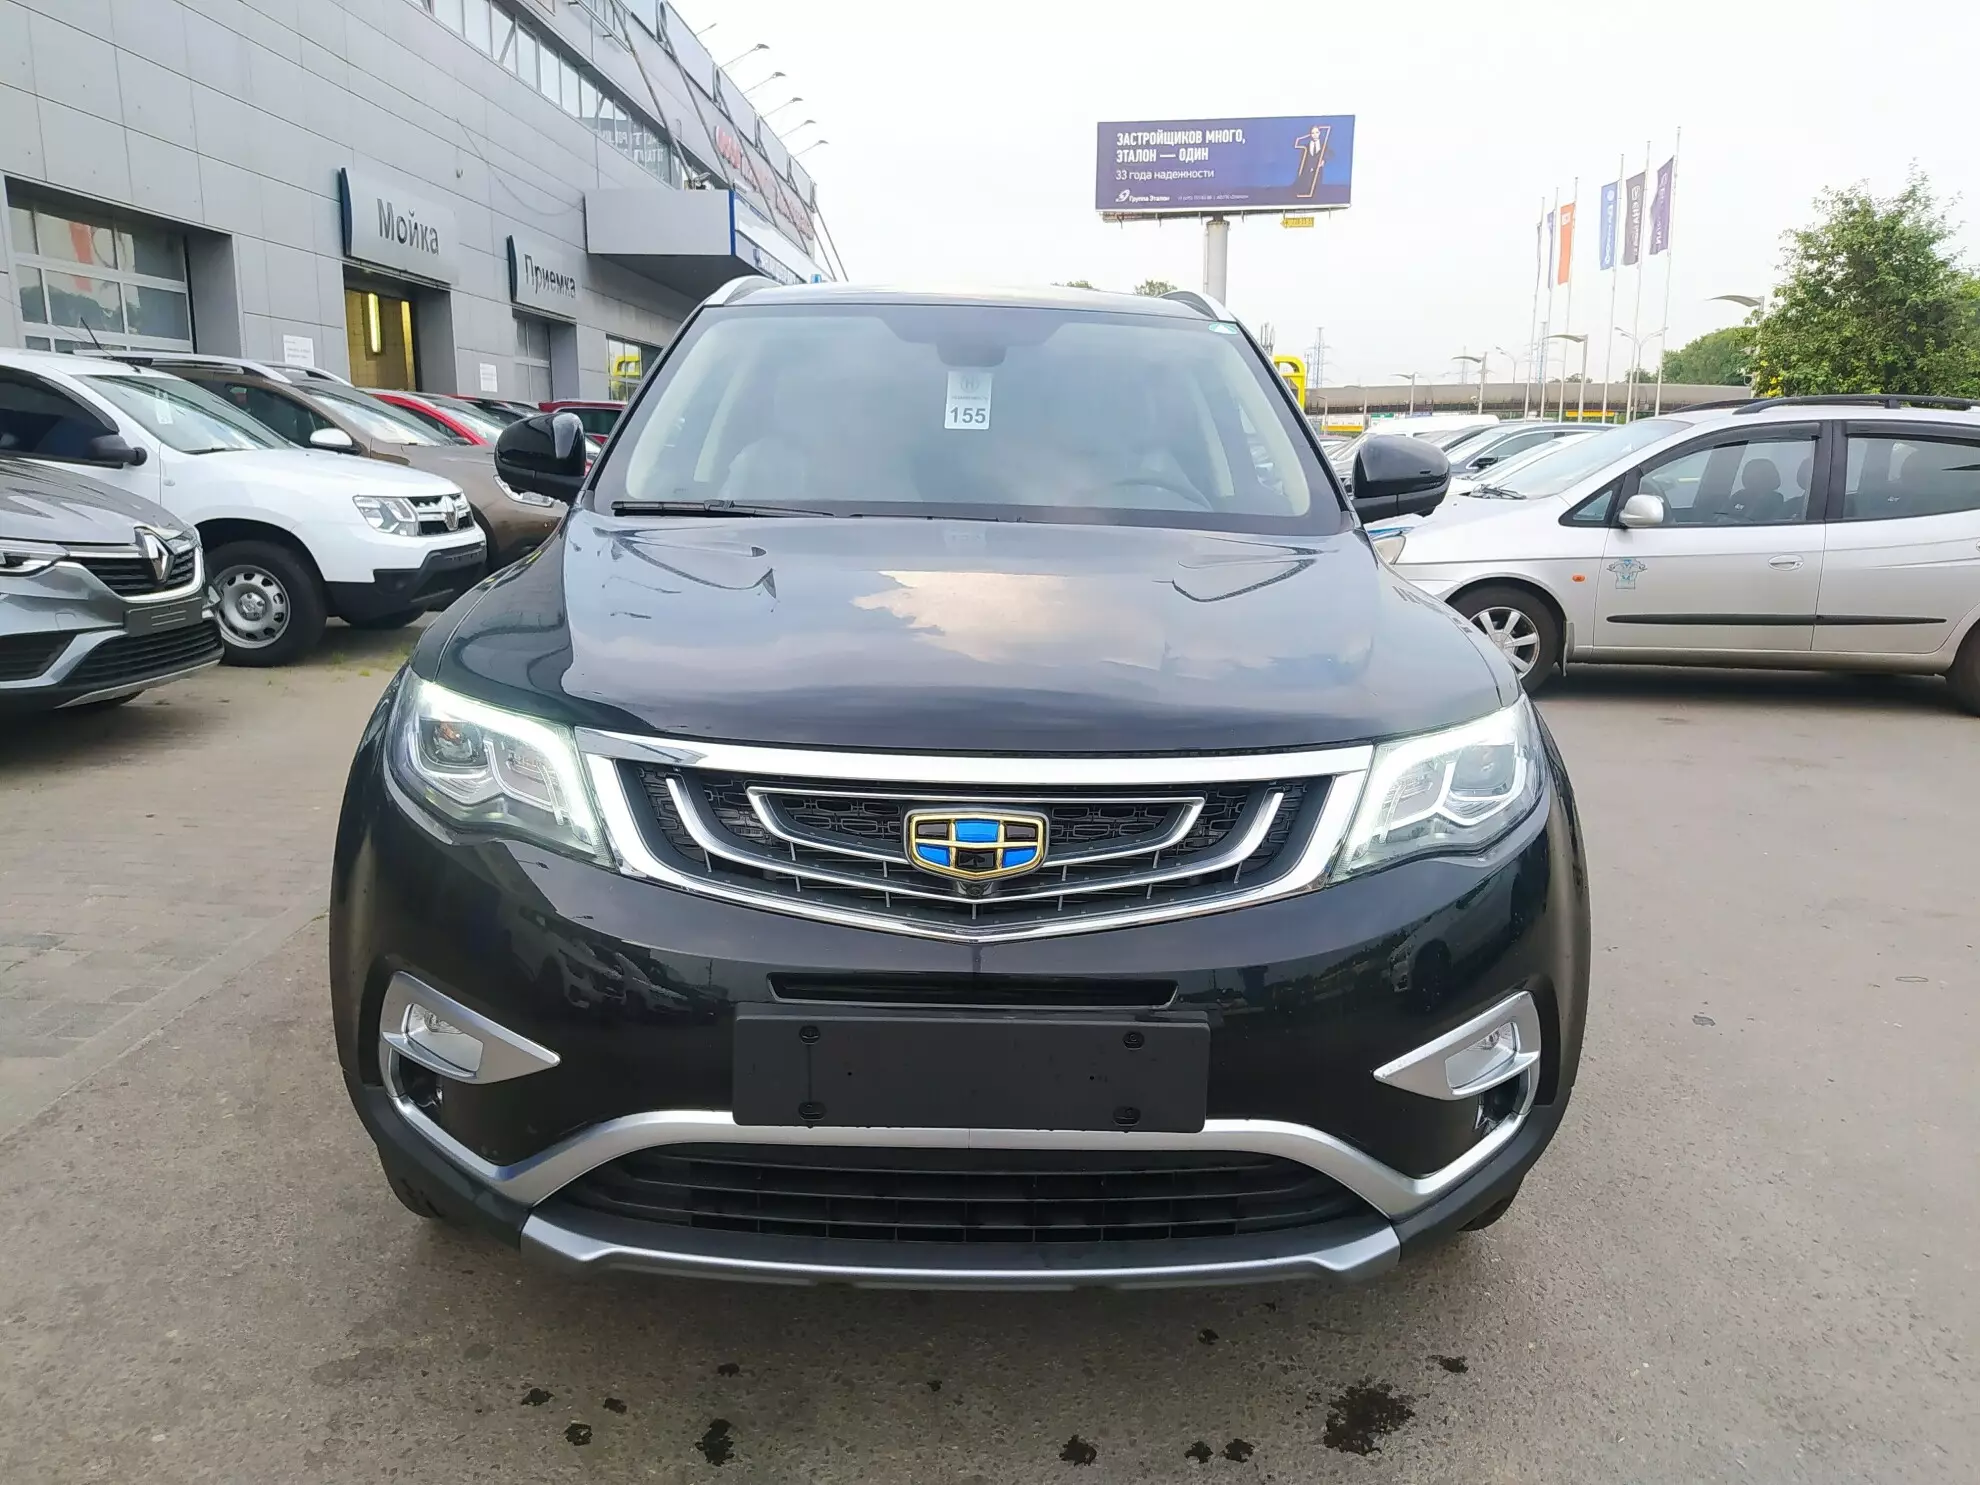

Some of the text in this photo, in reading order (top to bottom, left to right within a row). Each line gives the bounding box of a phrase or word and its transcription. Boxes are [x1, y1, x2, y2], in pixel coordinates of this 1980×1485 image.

[1116, 129, 1246, 147] ЗАСТРОЙЩИКОВ МНОГО,
[1116, 149, 1157, 163] ЭТАЛОН
[1178, 147, 1209, 163] ОДИН
[1116, 170, 1215, 181] 33 года надежности
[377, 198, 440, 256] Мойка
[523, 253, 577, 299] Приемка
[950, 406, 987, 424] 155
